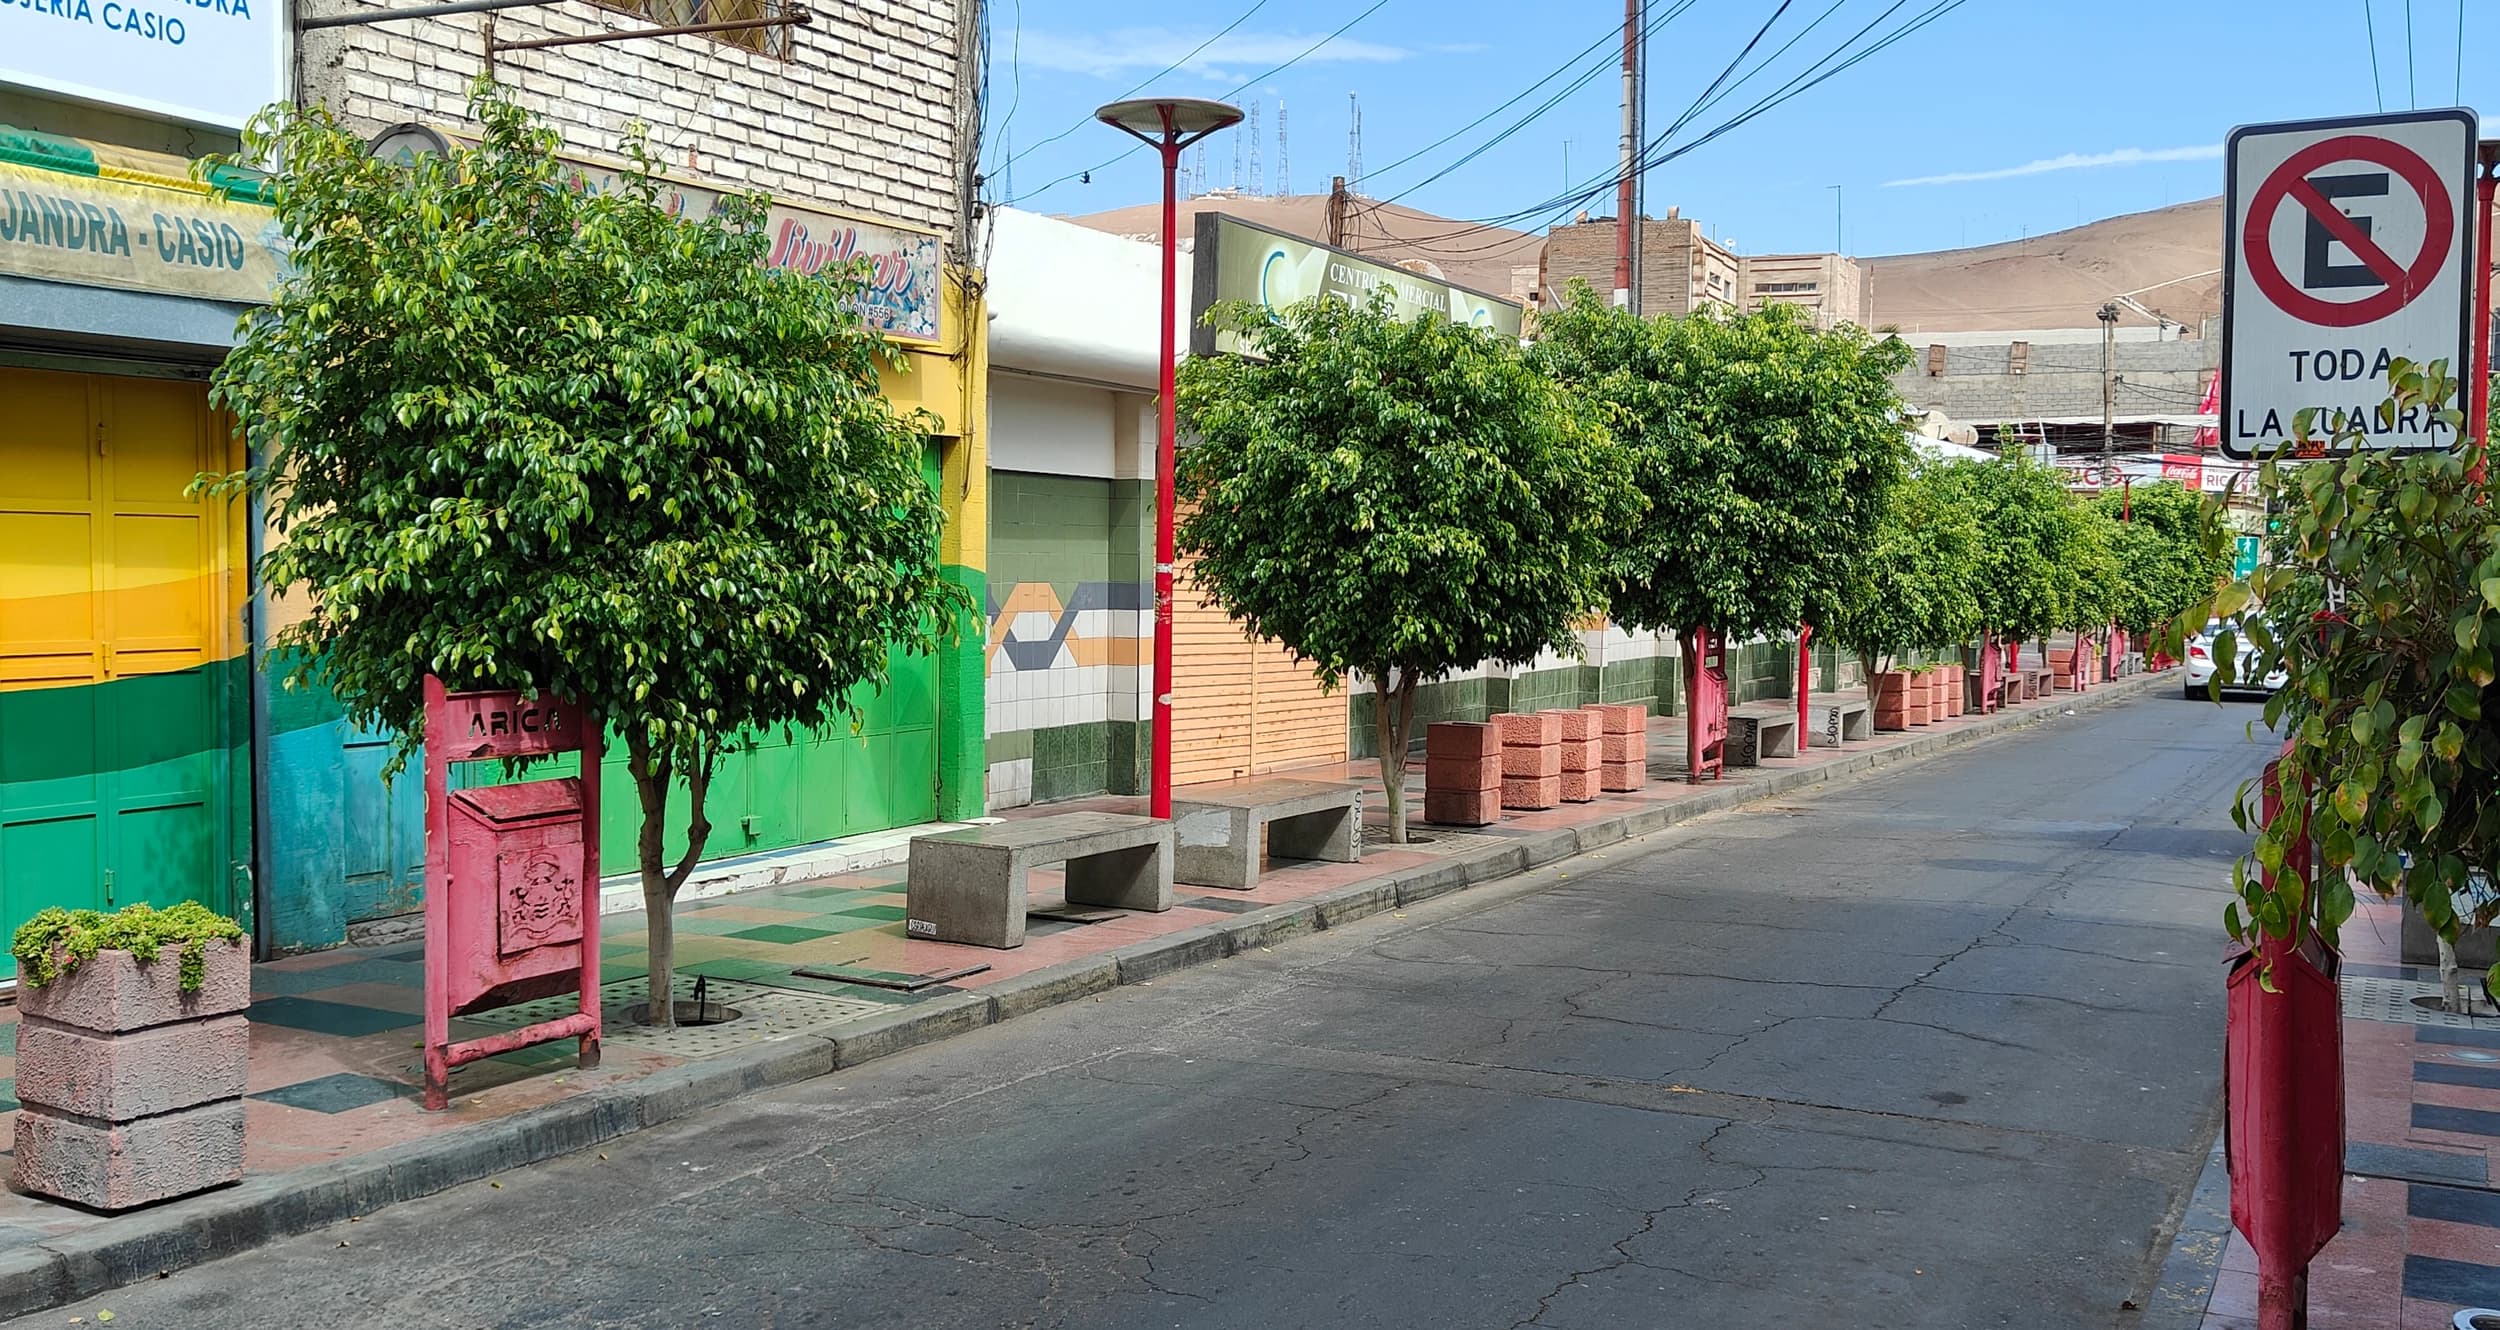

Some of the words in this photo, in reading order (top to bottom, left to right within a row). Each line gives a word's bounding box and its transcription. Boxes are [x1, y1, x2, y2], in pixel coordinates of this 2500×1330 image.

[103, 2, 186, 45] CASIO
[153, 212, 245, 272] CASIO
[1330, 262, 1378, 291] CENTRO
[868, 305, 890, 320] #556
[2289, 347, 2392, 383] TODA
[2238, 408, 2284, 438] LA
[468, 707, 561, 738] ARICA
